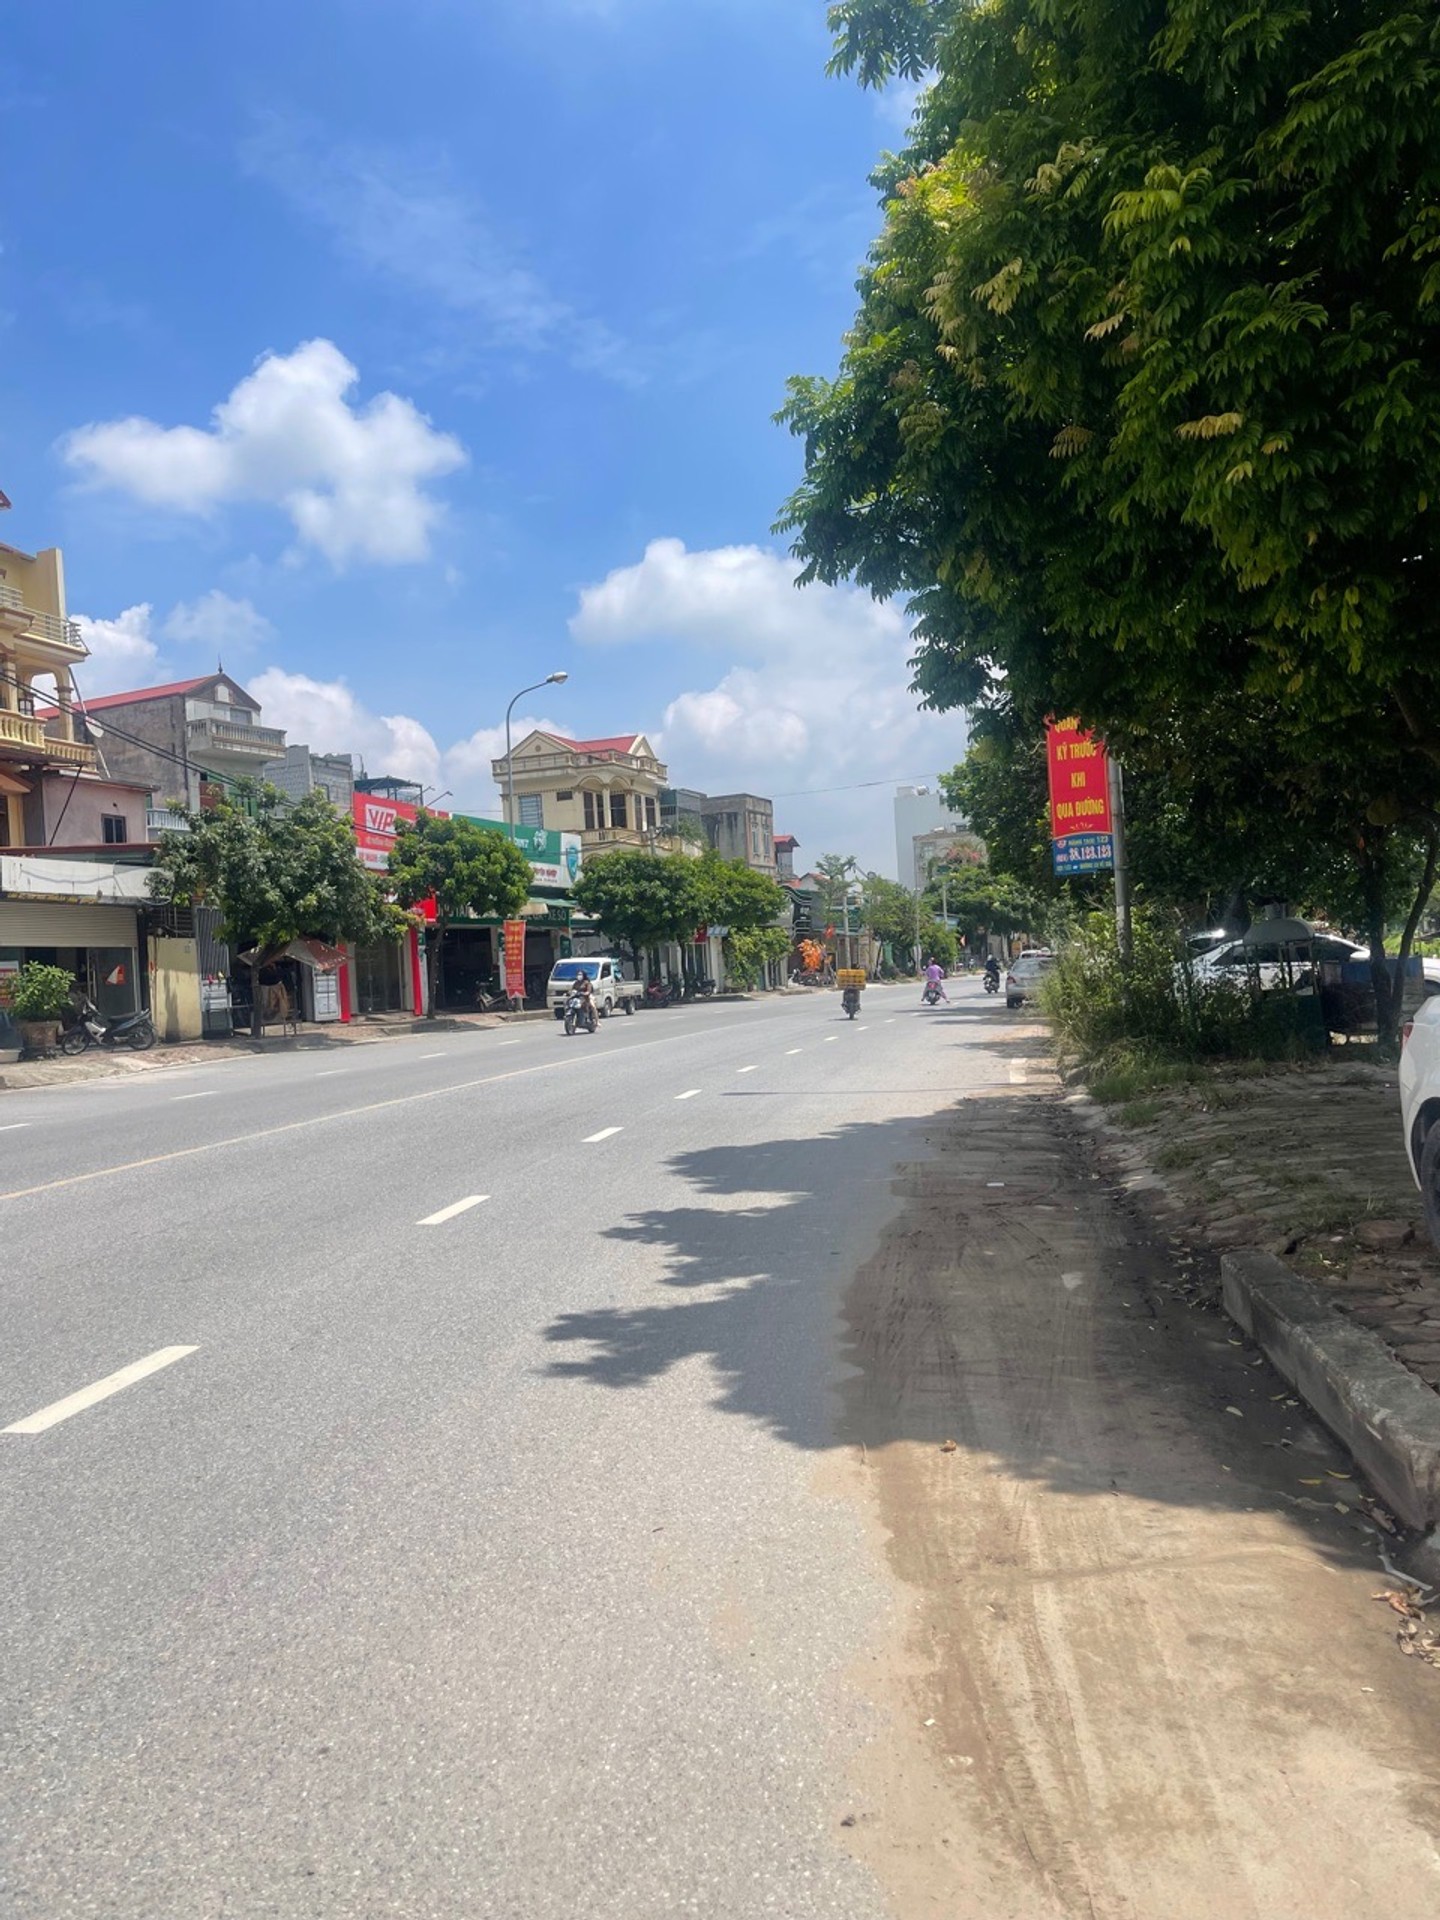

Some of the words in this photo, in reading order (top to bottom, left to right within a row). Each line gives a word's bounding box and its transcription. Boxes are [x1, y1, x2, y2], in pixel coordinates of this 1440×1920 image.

[1071, 771, 1086, 788] KHI
[368, 808, 395, 831] VIP
[1056, 802, 1073, 821] QUA
[1075, 796, 1105, 817] ĐƯỜNG
